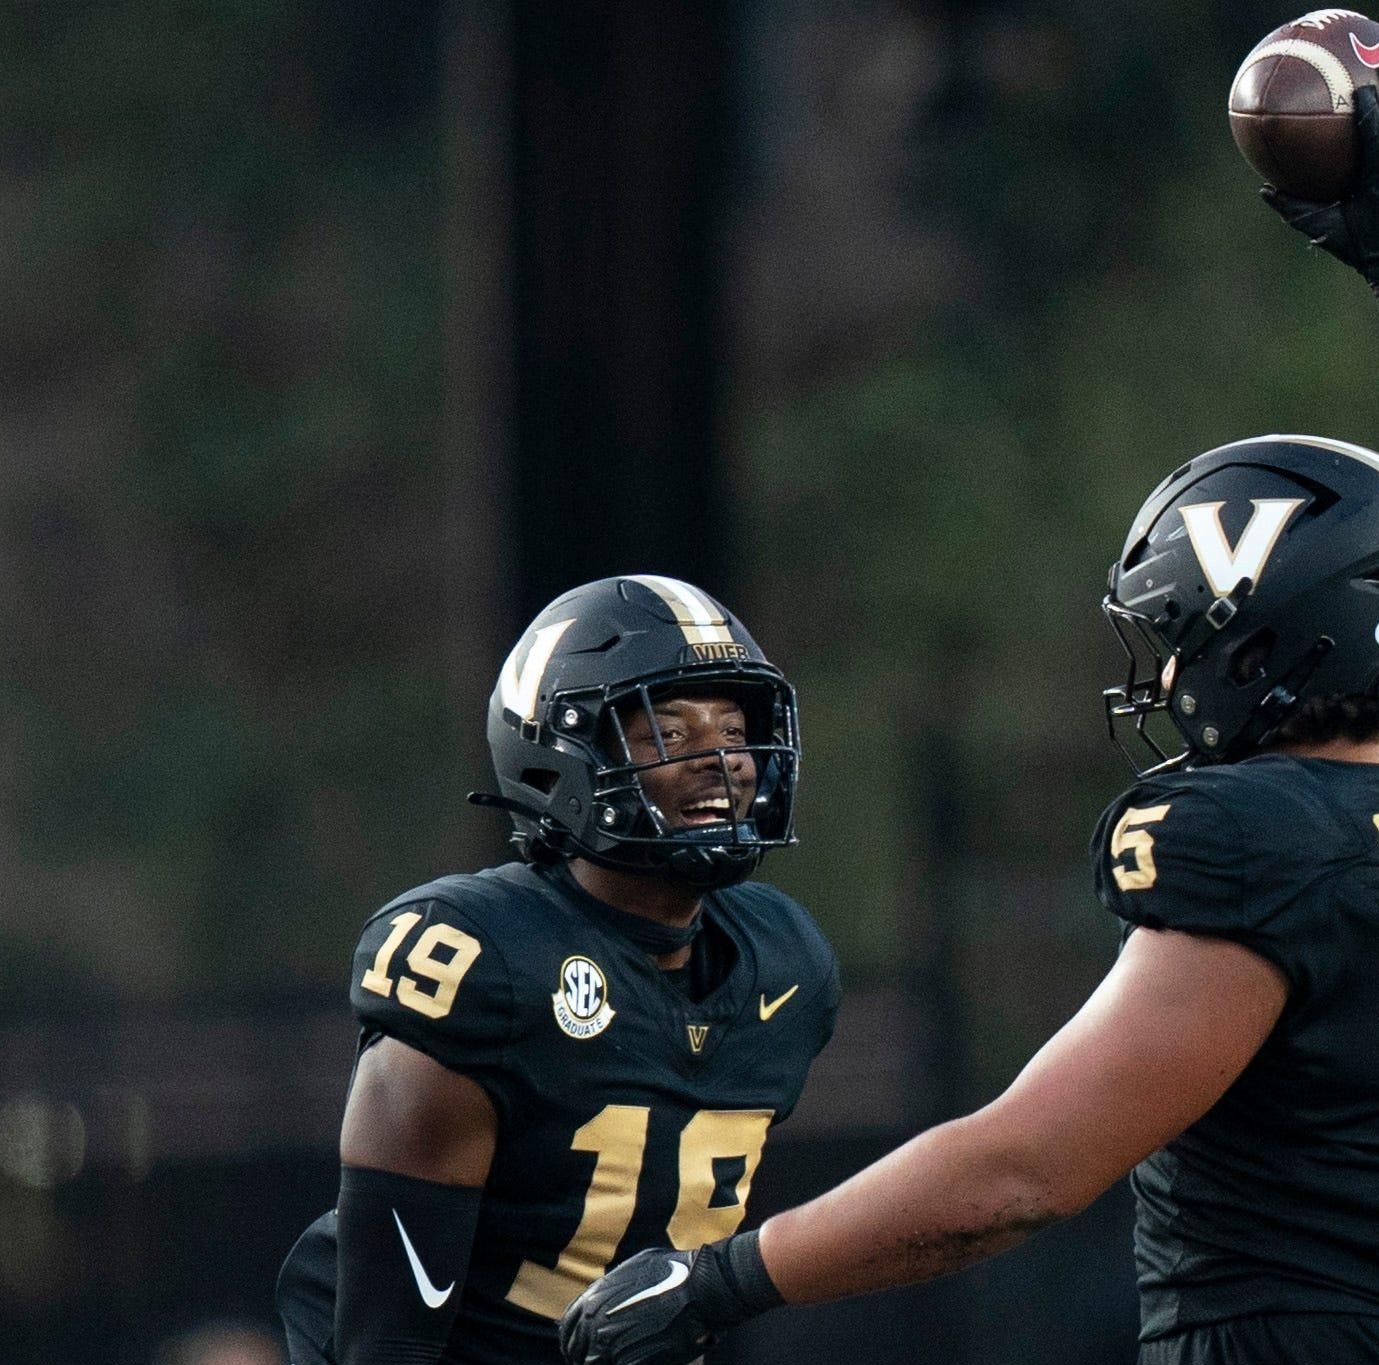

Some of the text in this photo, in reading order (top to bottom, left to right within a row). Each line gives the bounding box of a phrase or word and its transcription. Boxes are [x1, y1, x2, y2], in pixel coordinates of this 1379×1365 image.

[1178, 498, 1306, 597] V
[1111, 804, 1170, 892] 5
[361, 911, 482, 1019] 19
[564, 960, 603, 1018] SEC
[556, 1006, 604, 1036] GRADUATE
[687, 1025, 709, 1052] V
